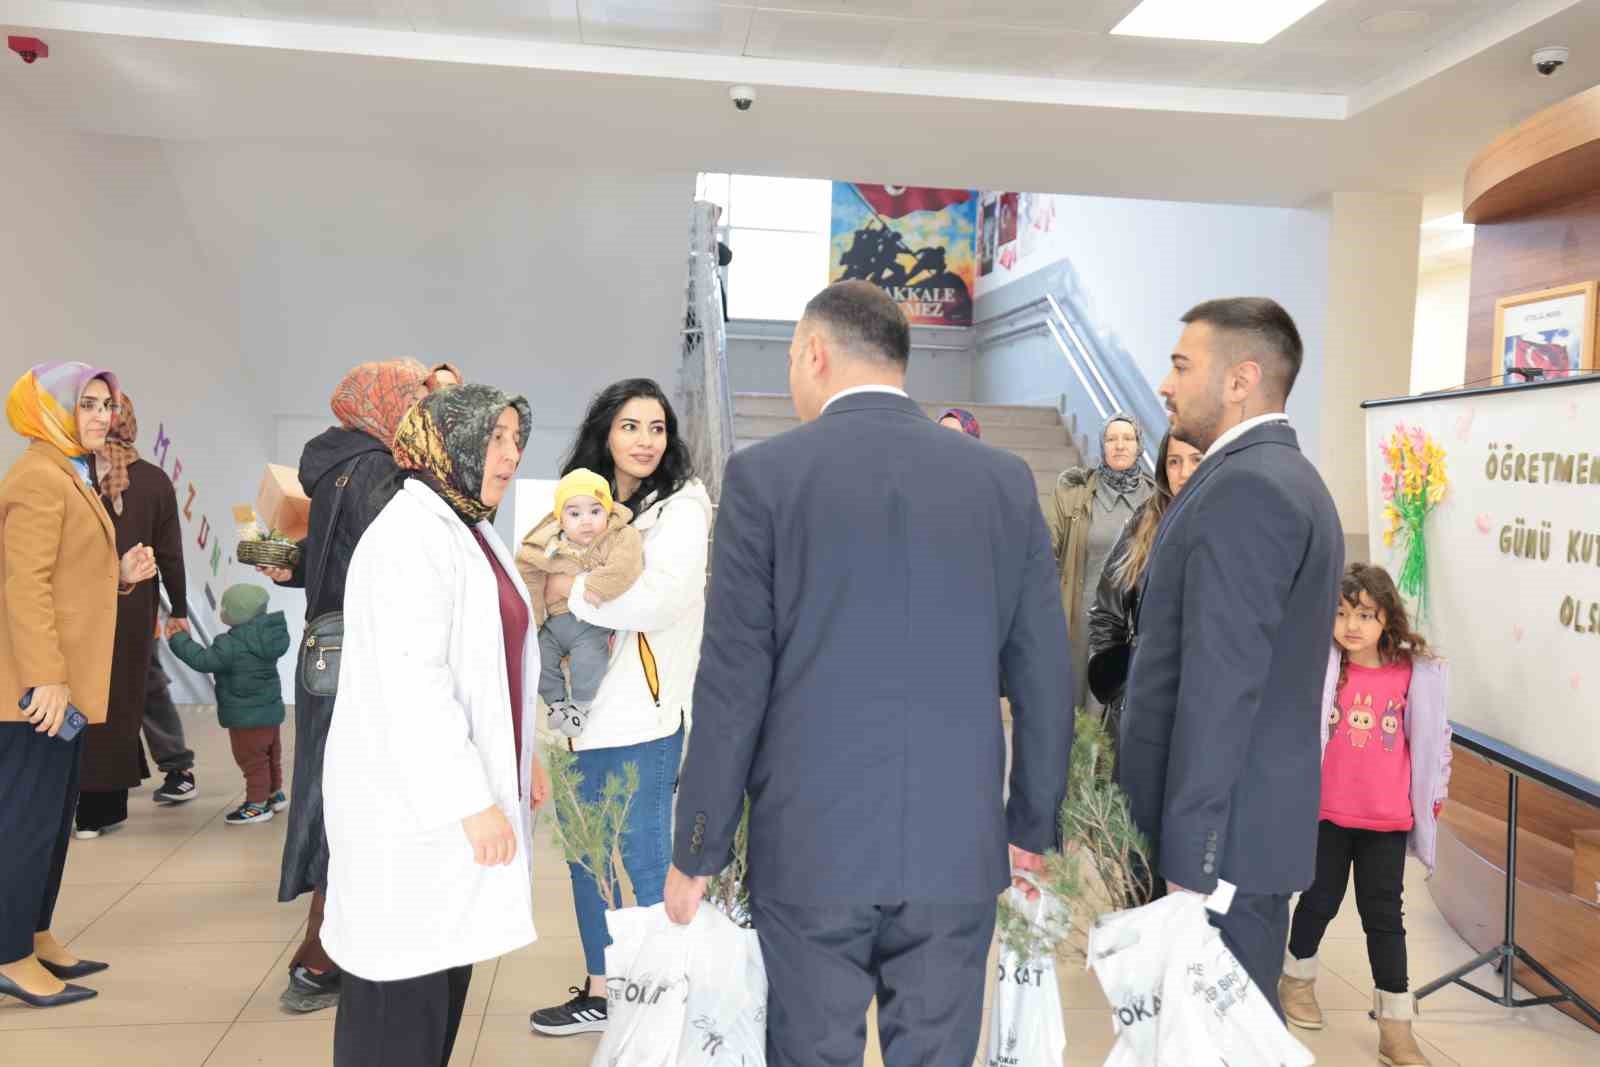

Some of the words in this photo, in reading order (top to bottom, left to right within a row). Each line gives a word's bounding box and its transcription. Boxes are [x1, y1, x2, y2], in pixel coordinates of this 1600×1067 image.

[882, 287, 955, 302] AKKALE
[1499, 517, 1551, 561] GÜNÜ
[1117, 996, 1161, 1025] OKA
